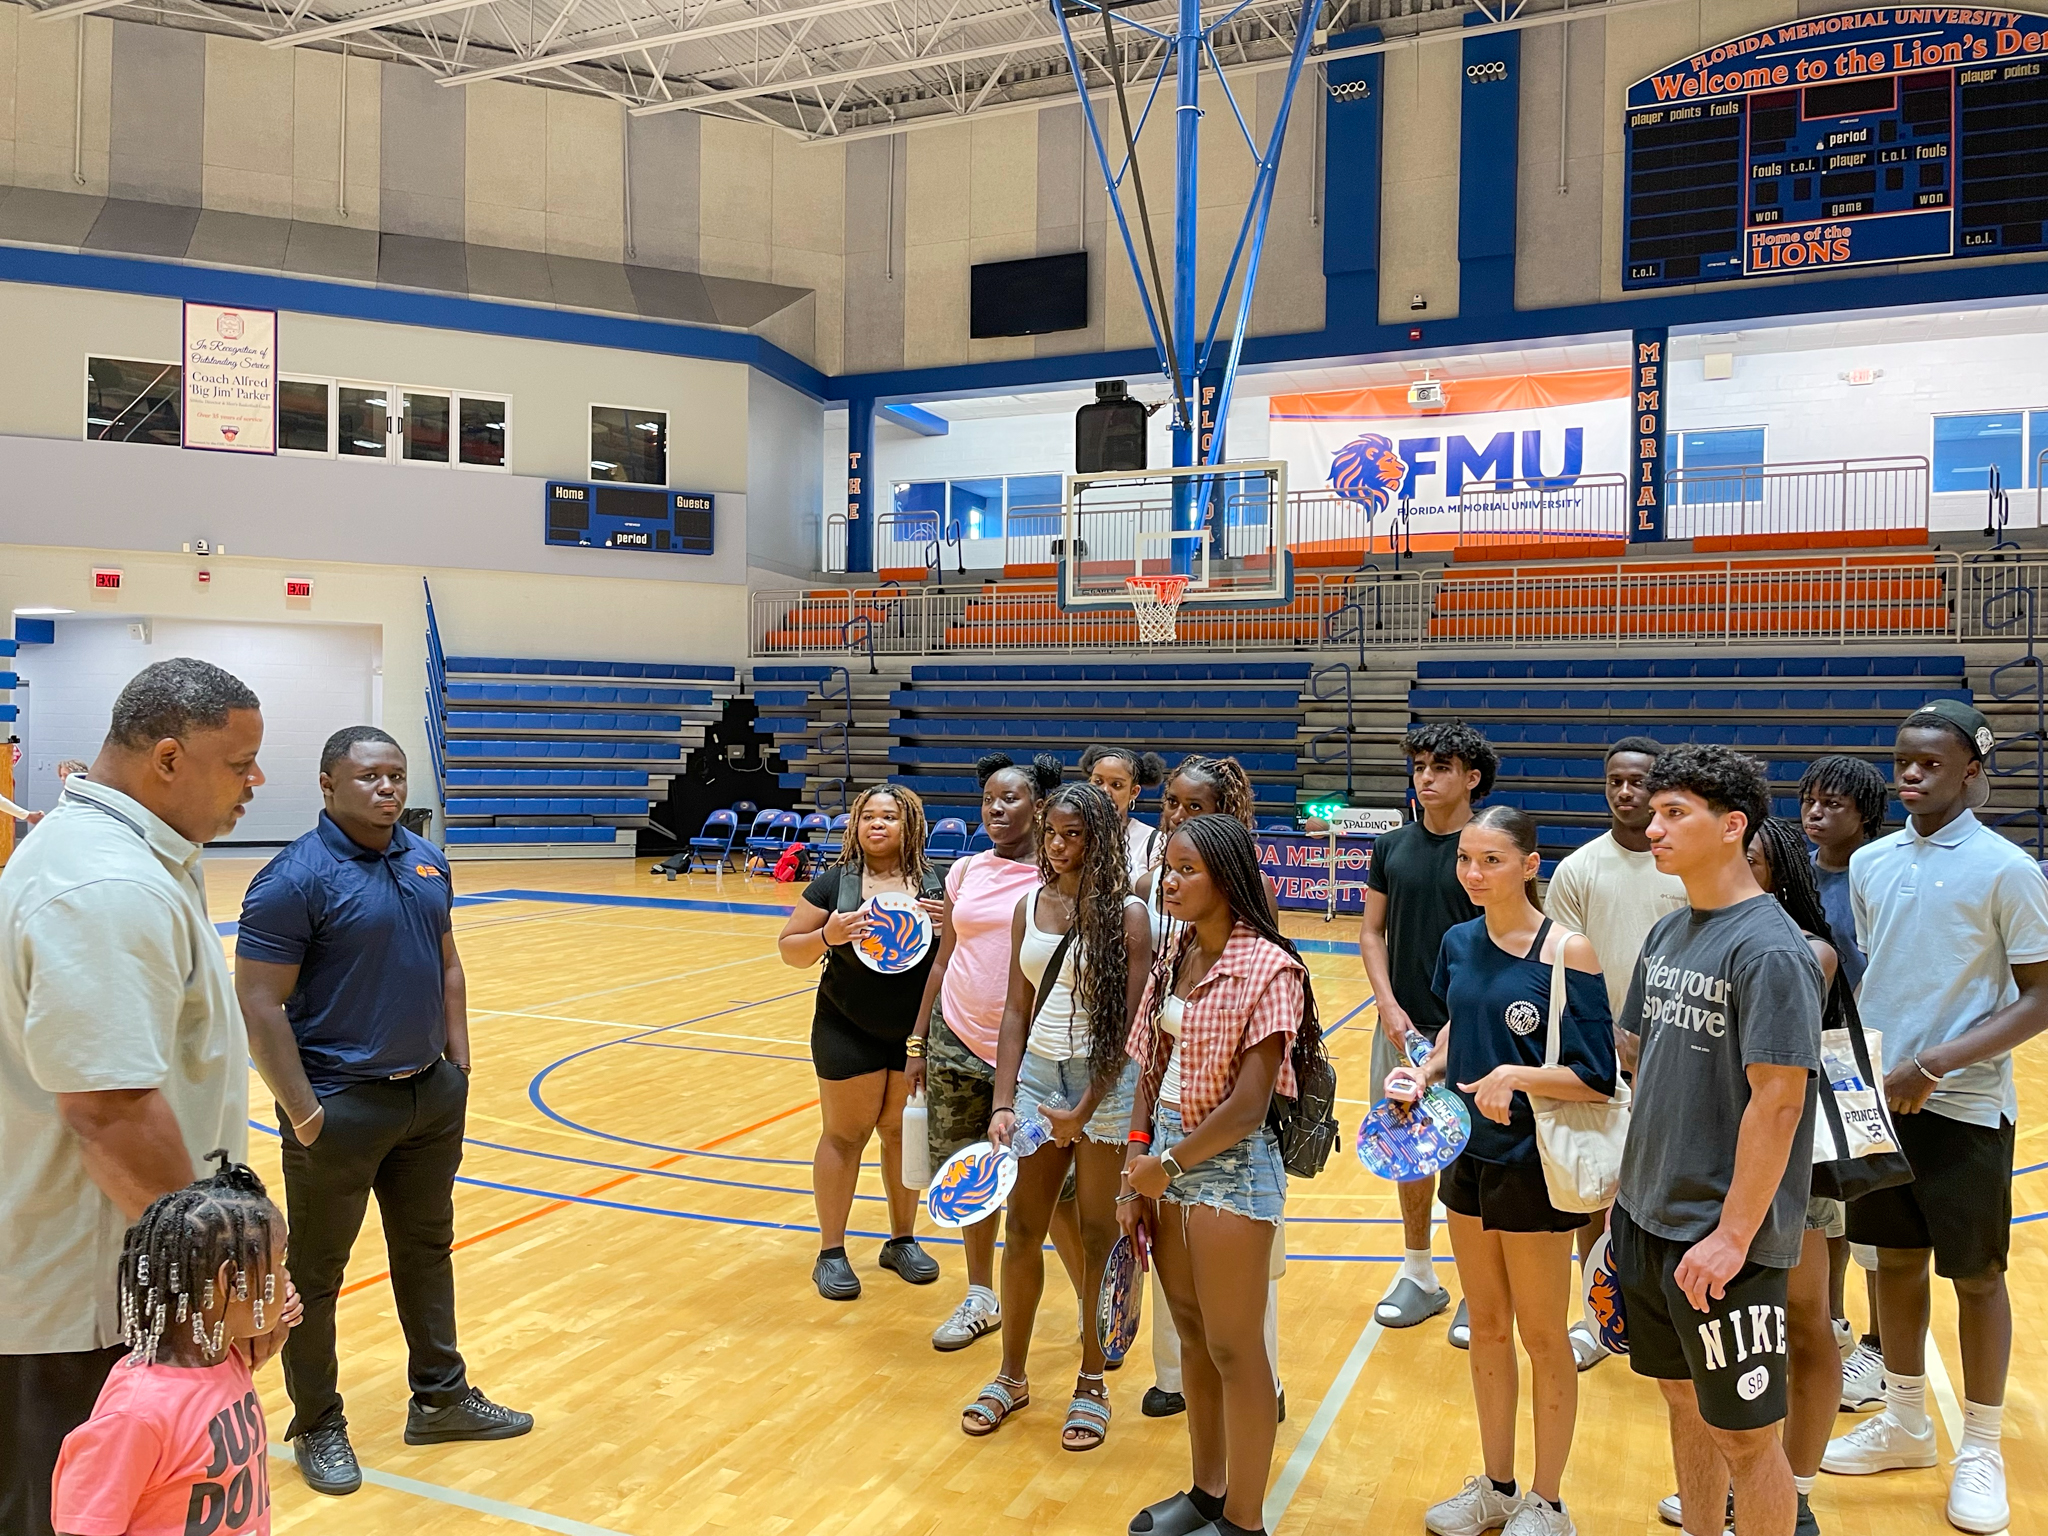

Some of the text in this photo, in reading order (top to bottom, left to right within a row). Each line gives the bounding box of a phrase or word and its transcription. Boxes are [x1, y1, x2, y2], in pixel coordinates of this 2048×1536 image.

[1690, 9, 2022, 72] FLORIDA MEMORIAL UNIVERSITY
[1651, 65, 1789, 101] Welcome
[1795, 58, 1828, 81] to
[1834, 48, 1885, 77] the
[1893, 34, 1988, 69] Lion's
[1960, 63, 2041, 85] player points
[1631, 101, 1739, 128] player points fouls
[1829, 128, 1867, 147] period
[1752, 144, 1947, 178] fouls t.o.l. player t.o.l. fouls
[1755, 192, 1943, 222] won game won
[1752, 224, 1852, 247] Home of the
[1966, 231, 1992, 245] t.o.l.
[1752, 238, 1850, 270] LIONS
[1632, 265, 1656, 278] t.o.l.
[190, 339, 268, 359] In Recognition of
[191, 352, 270, 370] Outstanding Service
[192, 371, 268, 388] Coach Alfred
[237, 388, 270, 401] Parker
[1637, 341, 1660, 530] MEMORIAL
[1202, 386, 1216, 543] FLODA
[1397, 427, 1583, 500] FMU
[555, 486, 584, 500] Home
[848, 453, 861, 520] THE
[676, 496, 710, 510] Guests
[1511, 499, 1582, 511] UNIVERSITY
[616, 533, 647, 545] period
[97, 574, 119, 588] EXIT
[288, 583, 309, 596] EXIT
[1343, 819, 1387, 831] SPALDING
[1675, 969, 1732, 1007] your
[1698, 1305, 1786, 1371] NIKE
[1748, 1373, 1763, 1394] SB
[184, 1465, 253, 1536] DO
